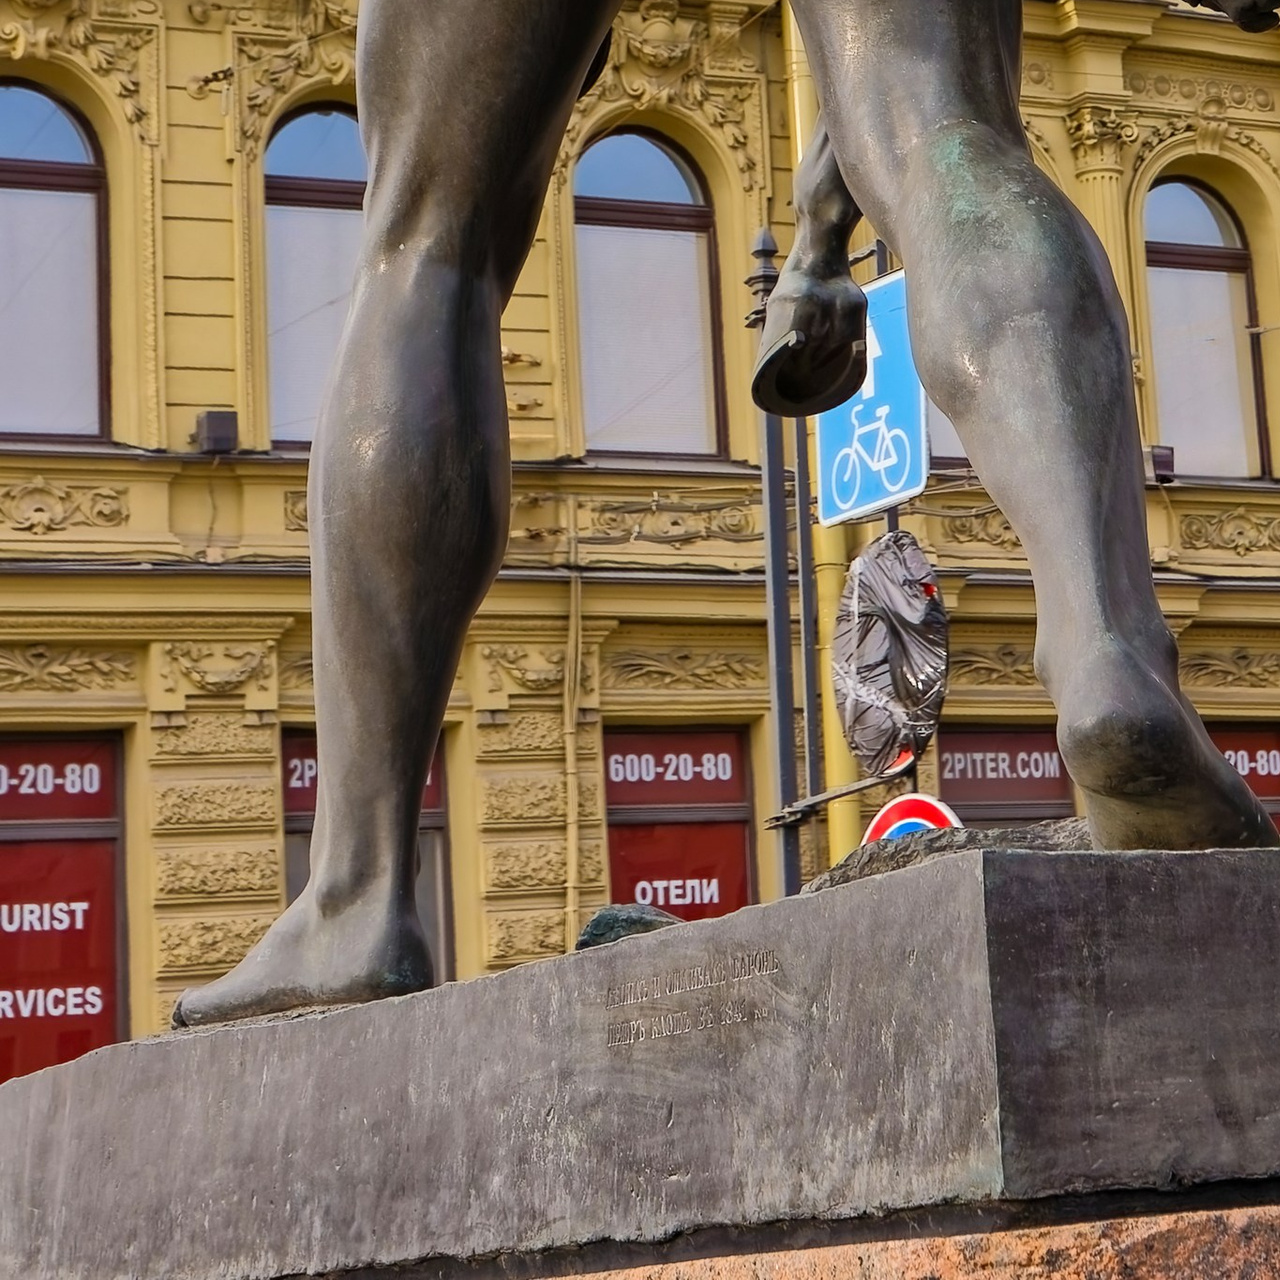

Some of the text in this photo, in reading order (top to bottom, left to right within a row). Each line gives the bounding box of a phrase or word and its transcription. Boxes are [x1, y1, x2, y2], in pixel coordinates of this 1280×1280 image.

[289, 758, 317, 788] 2P
[609, 753, 732, 782] 600-20-80
[942, 751, 1060, 779] 2PITER.COM
[634, 878, 719, 905] ОТЕЛИ
[0, 902, 90, 932] URIST
